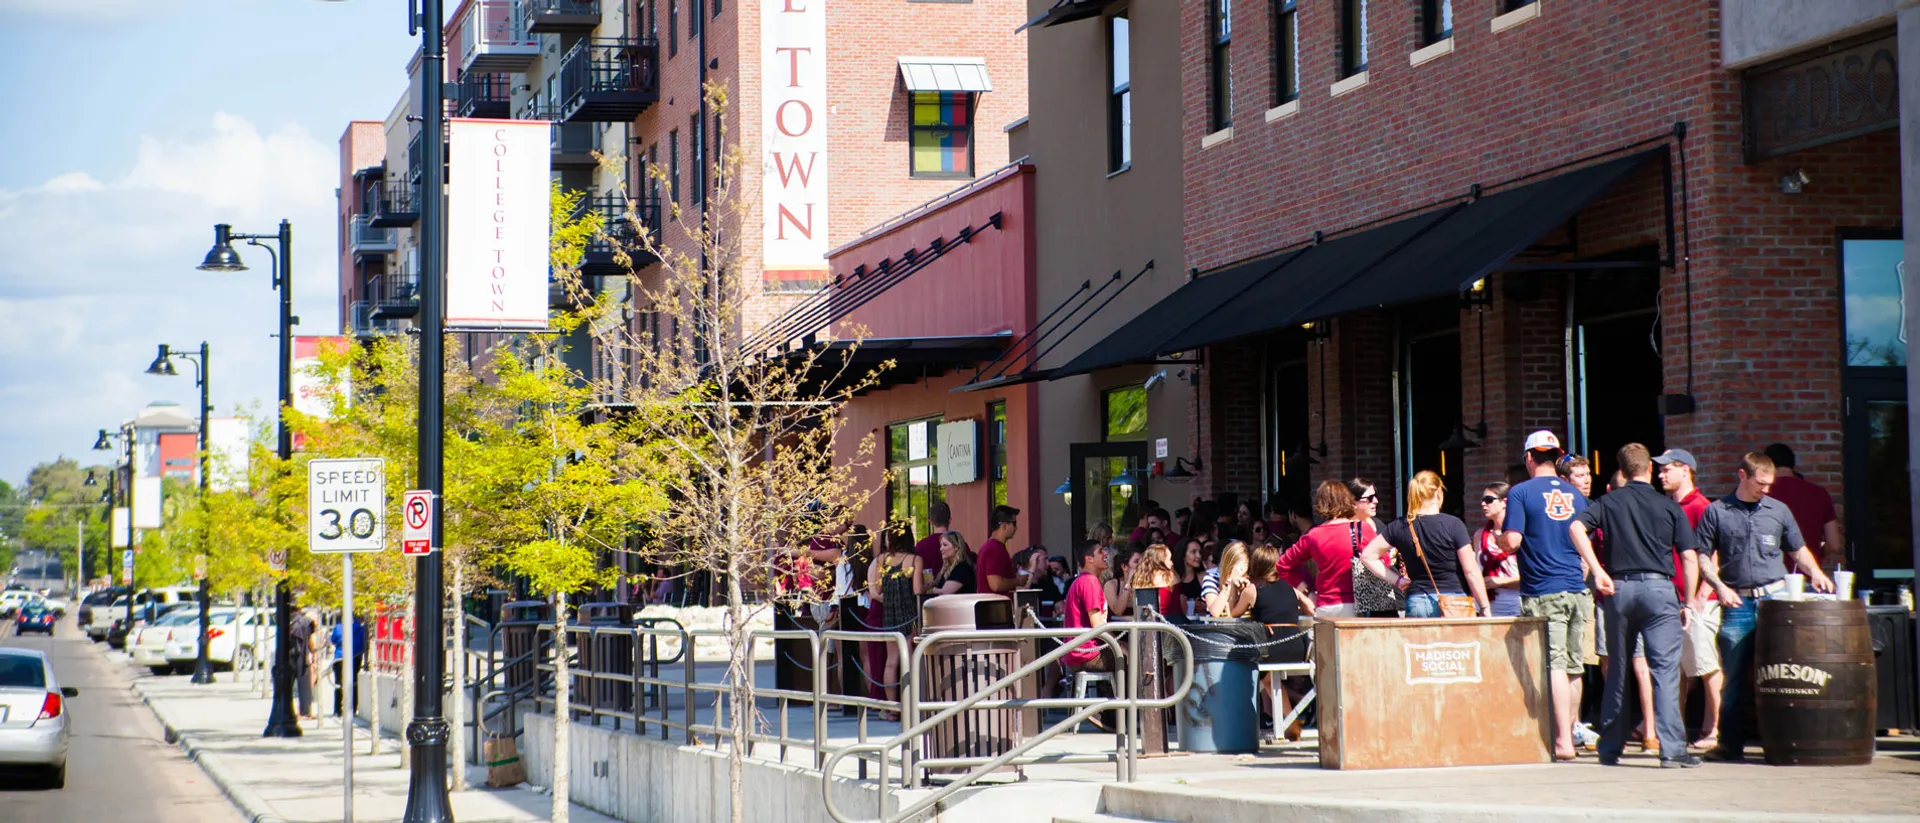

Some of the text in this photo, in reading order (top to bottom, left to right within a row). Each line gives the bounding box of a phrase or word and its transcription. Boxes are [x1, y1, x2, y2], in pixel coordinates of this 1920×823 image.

[773, 47, 818, 240] TOWN
[491, 129, 507, 312] COLLEGE TOWN
[949, 443, 972, 460] CANTINA
[316, 470, 377, 485] SPEED
[322, 489, 370, 503] LIMIT
[318, 508, 376, 540] 30
[1414, 650, 1471, 662] MADISON
[1421, 661, 1465, 671] SOCIAL
[1756, 663, 1828, 687] JAMESON
[1778, 687, 1820, 695] WHISKEY
